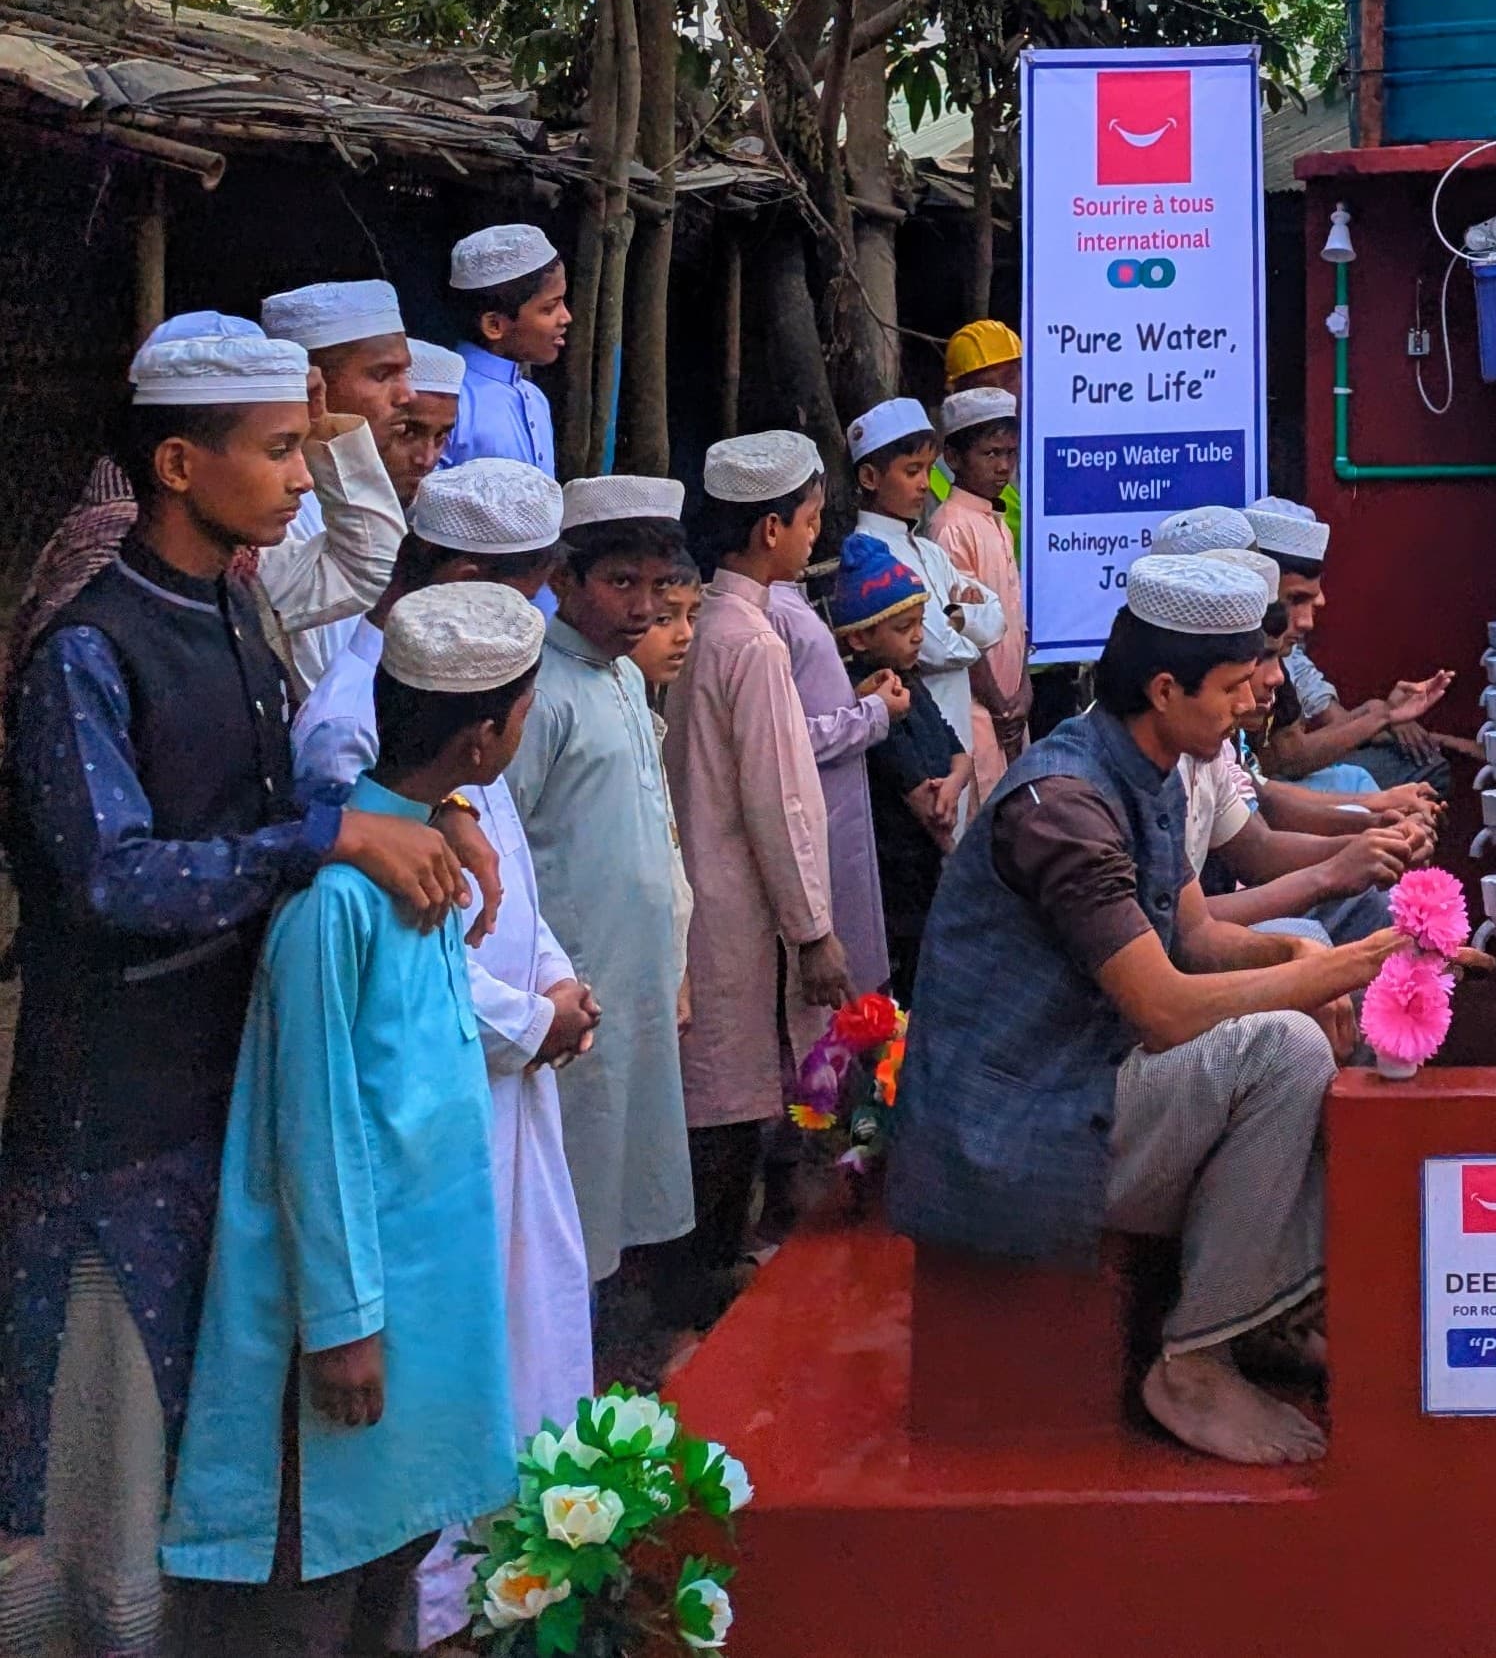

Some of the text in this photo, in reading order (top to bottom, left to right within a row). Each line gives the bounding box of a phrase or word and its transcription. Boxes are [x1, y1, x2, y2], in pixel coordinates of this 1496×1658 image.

[1073, 194, 1213, 216] Sourire à tous
[1078, 228, 1210, 251] international
[1048, 323, 1235, 353] “Pure Water,
[1072, 370, 1215, 403] Pure Life”
[1058, 442, 1232, 471] "Deep Water Tube
[1119, 479, 1170, 500] Well"
[1049, 529, 1152, 556] Rohingya-B
[1099, 566, 1126, 592] Ja
[1453, 1306, 1477, 1316] FOR
